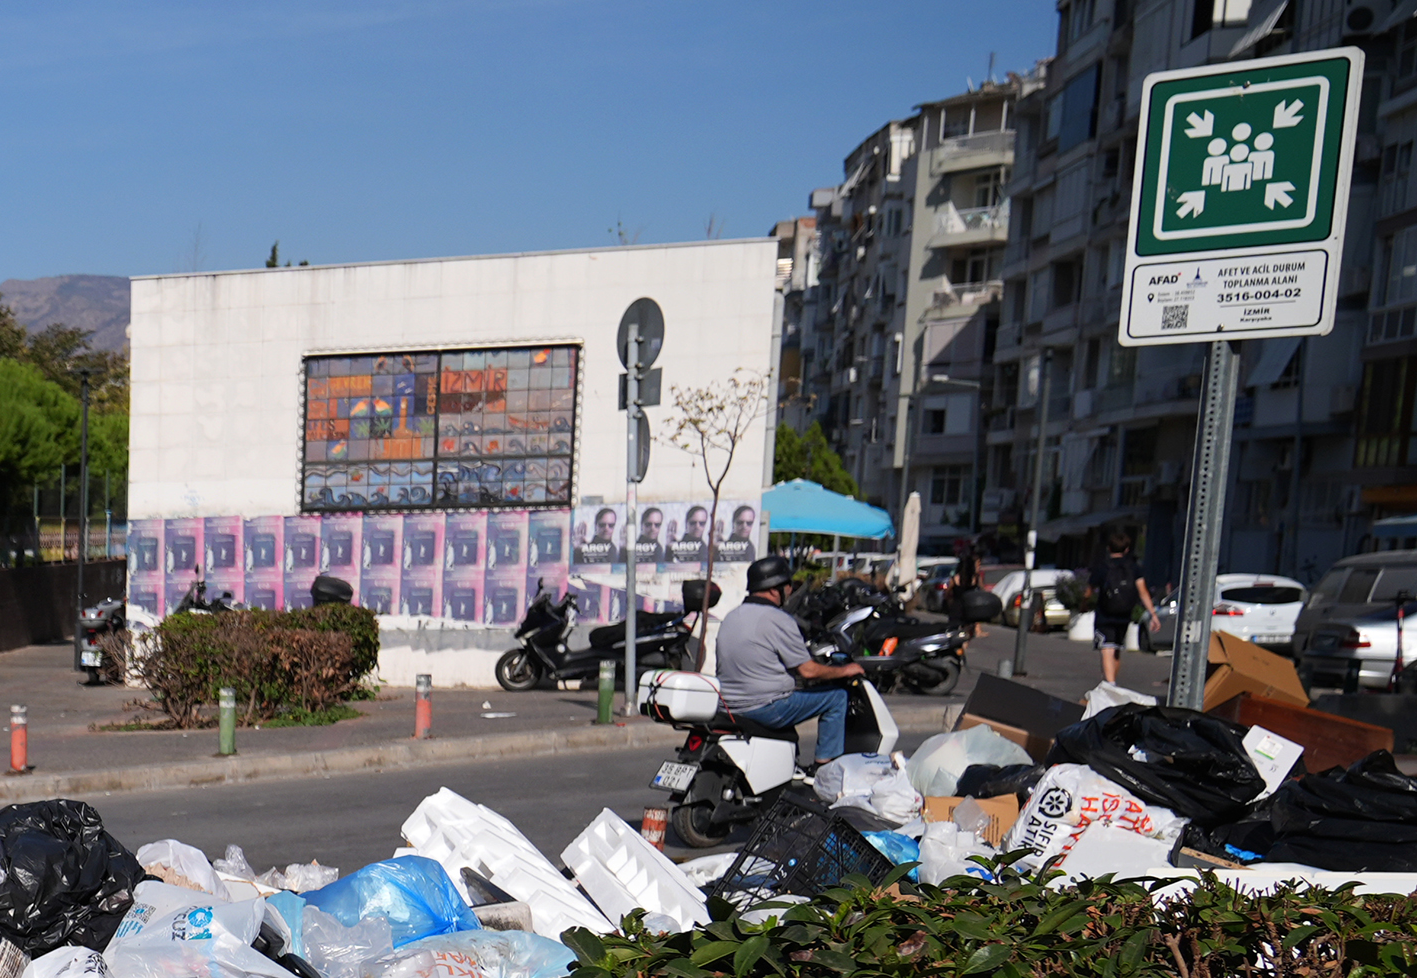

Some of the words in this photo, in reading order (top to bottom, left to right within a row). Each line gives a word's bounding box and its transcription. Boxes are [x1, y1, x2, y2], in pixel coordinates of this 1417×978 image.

[1217, 268, 1238, 278] AFET
[1240, 266, 1250, 275] VE
[1251, 263, 1270, 275] ACİL
[1272, 261, 1306, 273] DURUM
[1148, 275, 1179, 286] AFAD
[1223, 277, 1270, 289] TOPLANMA
[1270, 274, 1298, 285] ALANI
[1217, 287, 1302, 303] 3516-004-02
[1243, 307, 1270, 316] İZMİR
[442, 365, 506, 393] İZMİR
[582, 543, 612, 553] ARGY
[635, 543, 658, 553] RGY
[671, 541, 702, 551] ARGY
[718, 541, 749, 551] ARGY
